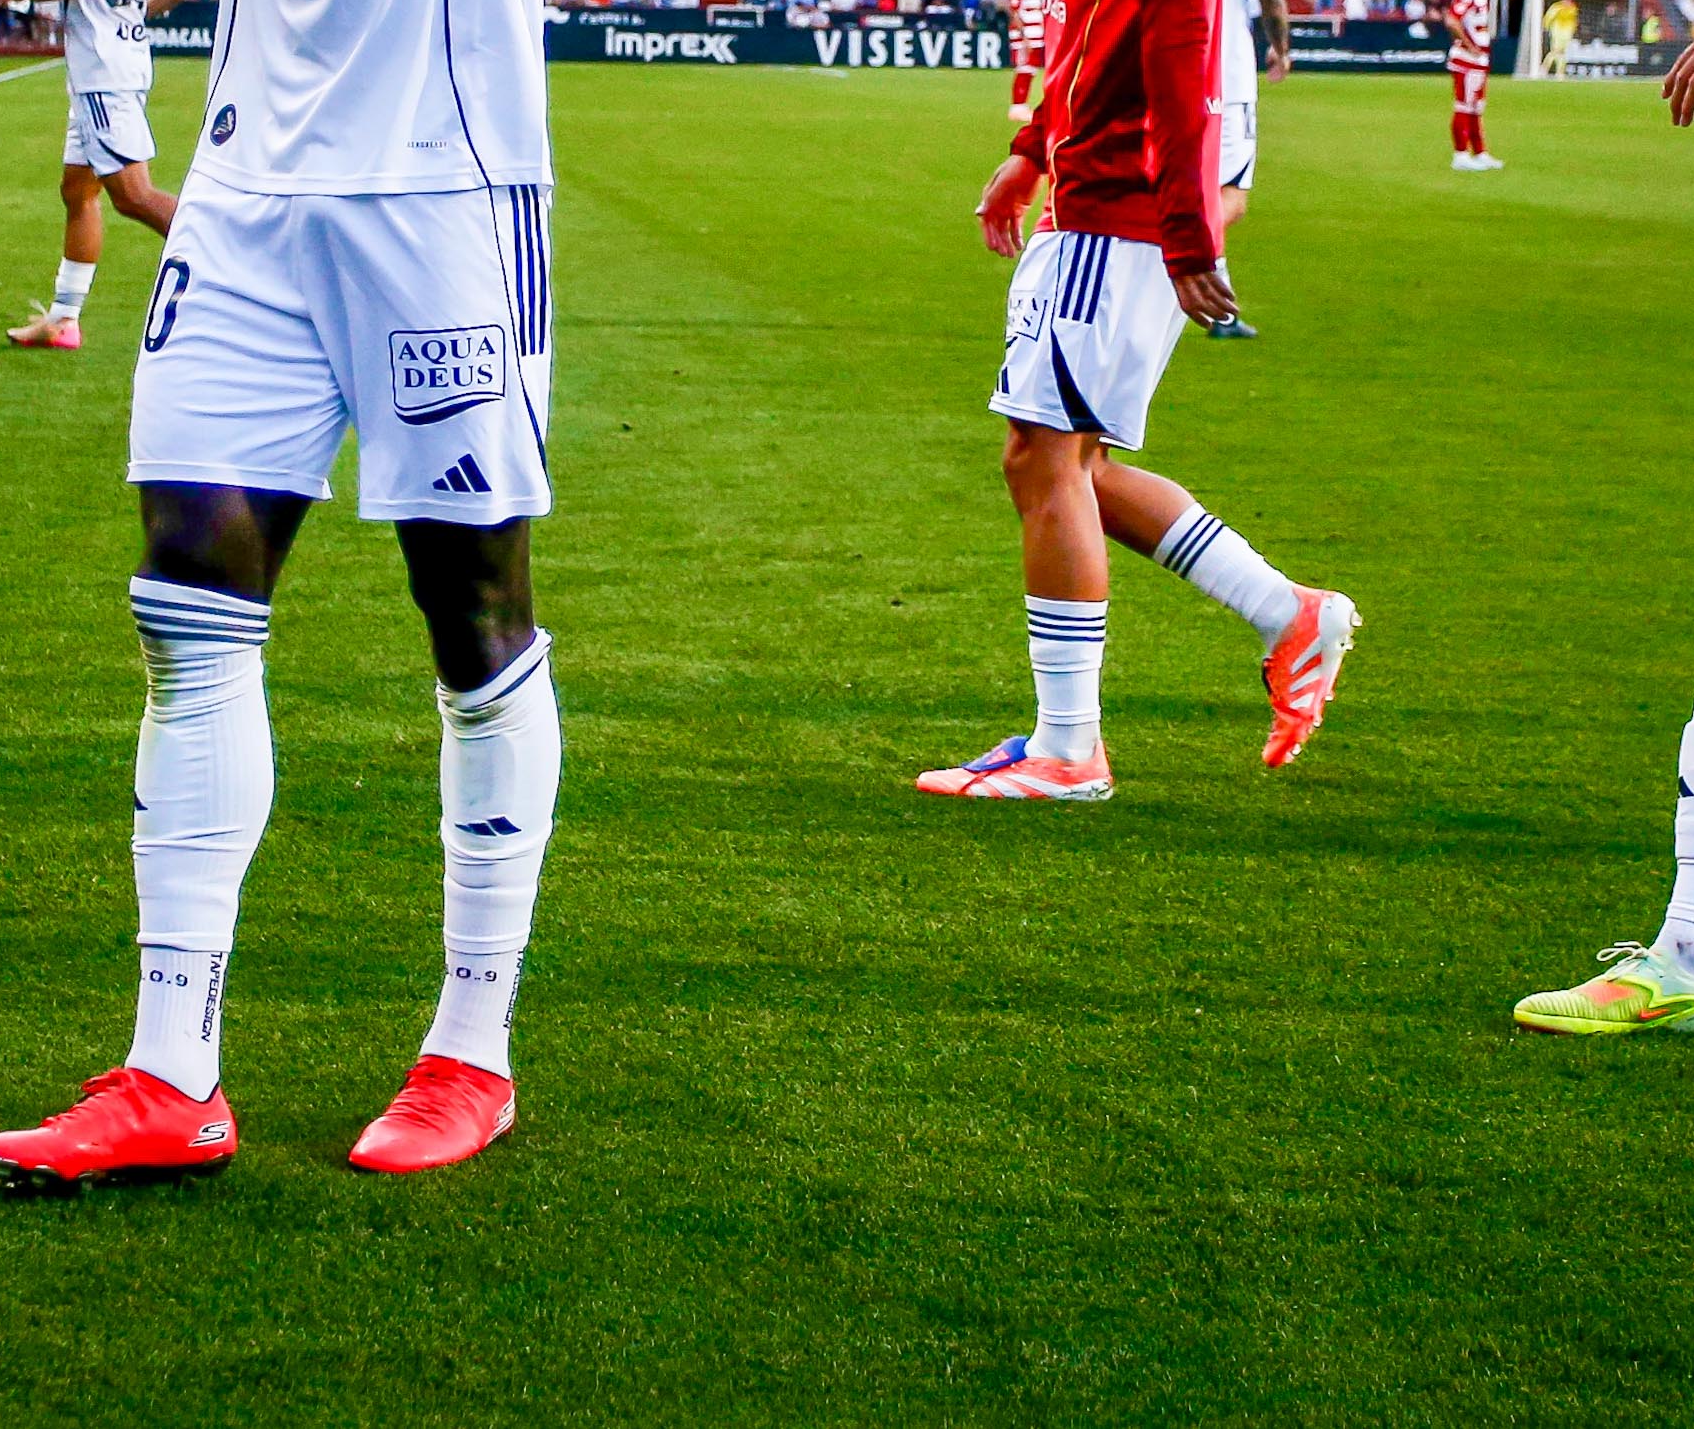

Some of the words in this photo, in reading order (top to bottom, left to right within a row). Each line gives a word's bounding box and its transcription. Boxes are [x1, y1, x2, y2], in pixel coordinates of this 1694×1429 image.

[813, 28, 1003, 69] VISEVER
[398, 335, 496, 365] AQUA
[403, 363, 493, 388] DEUS
[201, 951, 223, 1043] TAPEDESIGN
